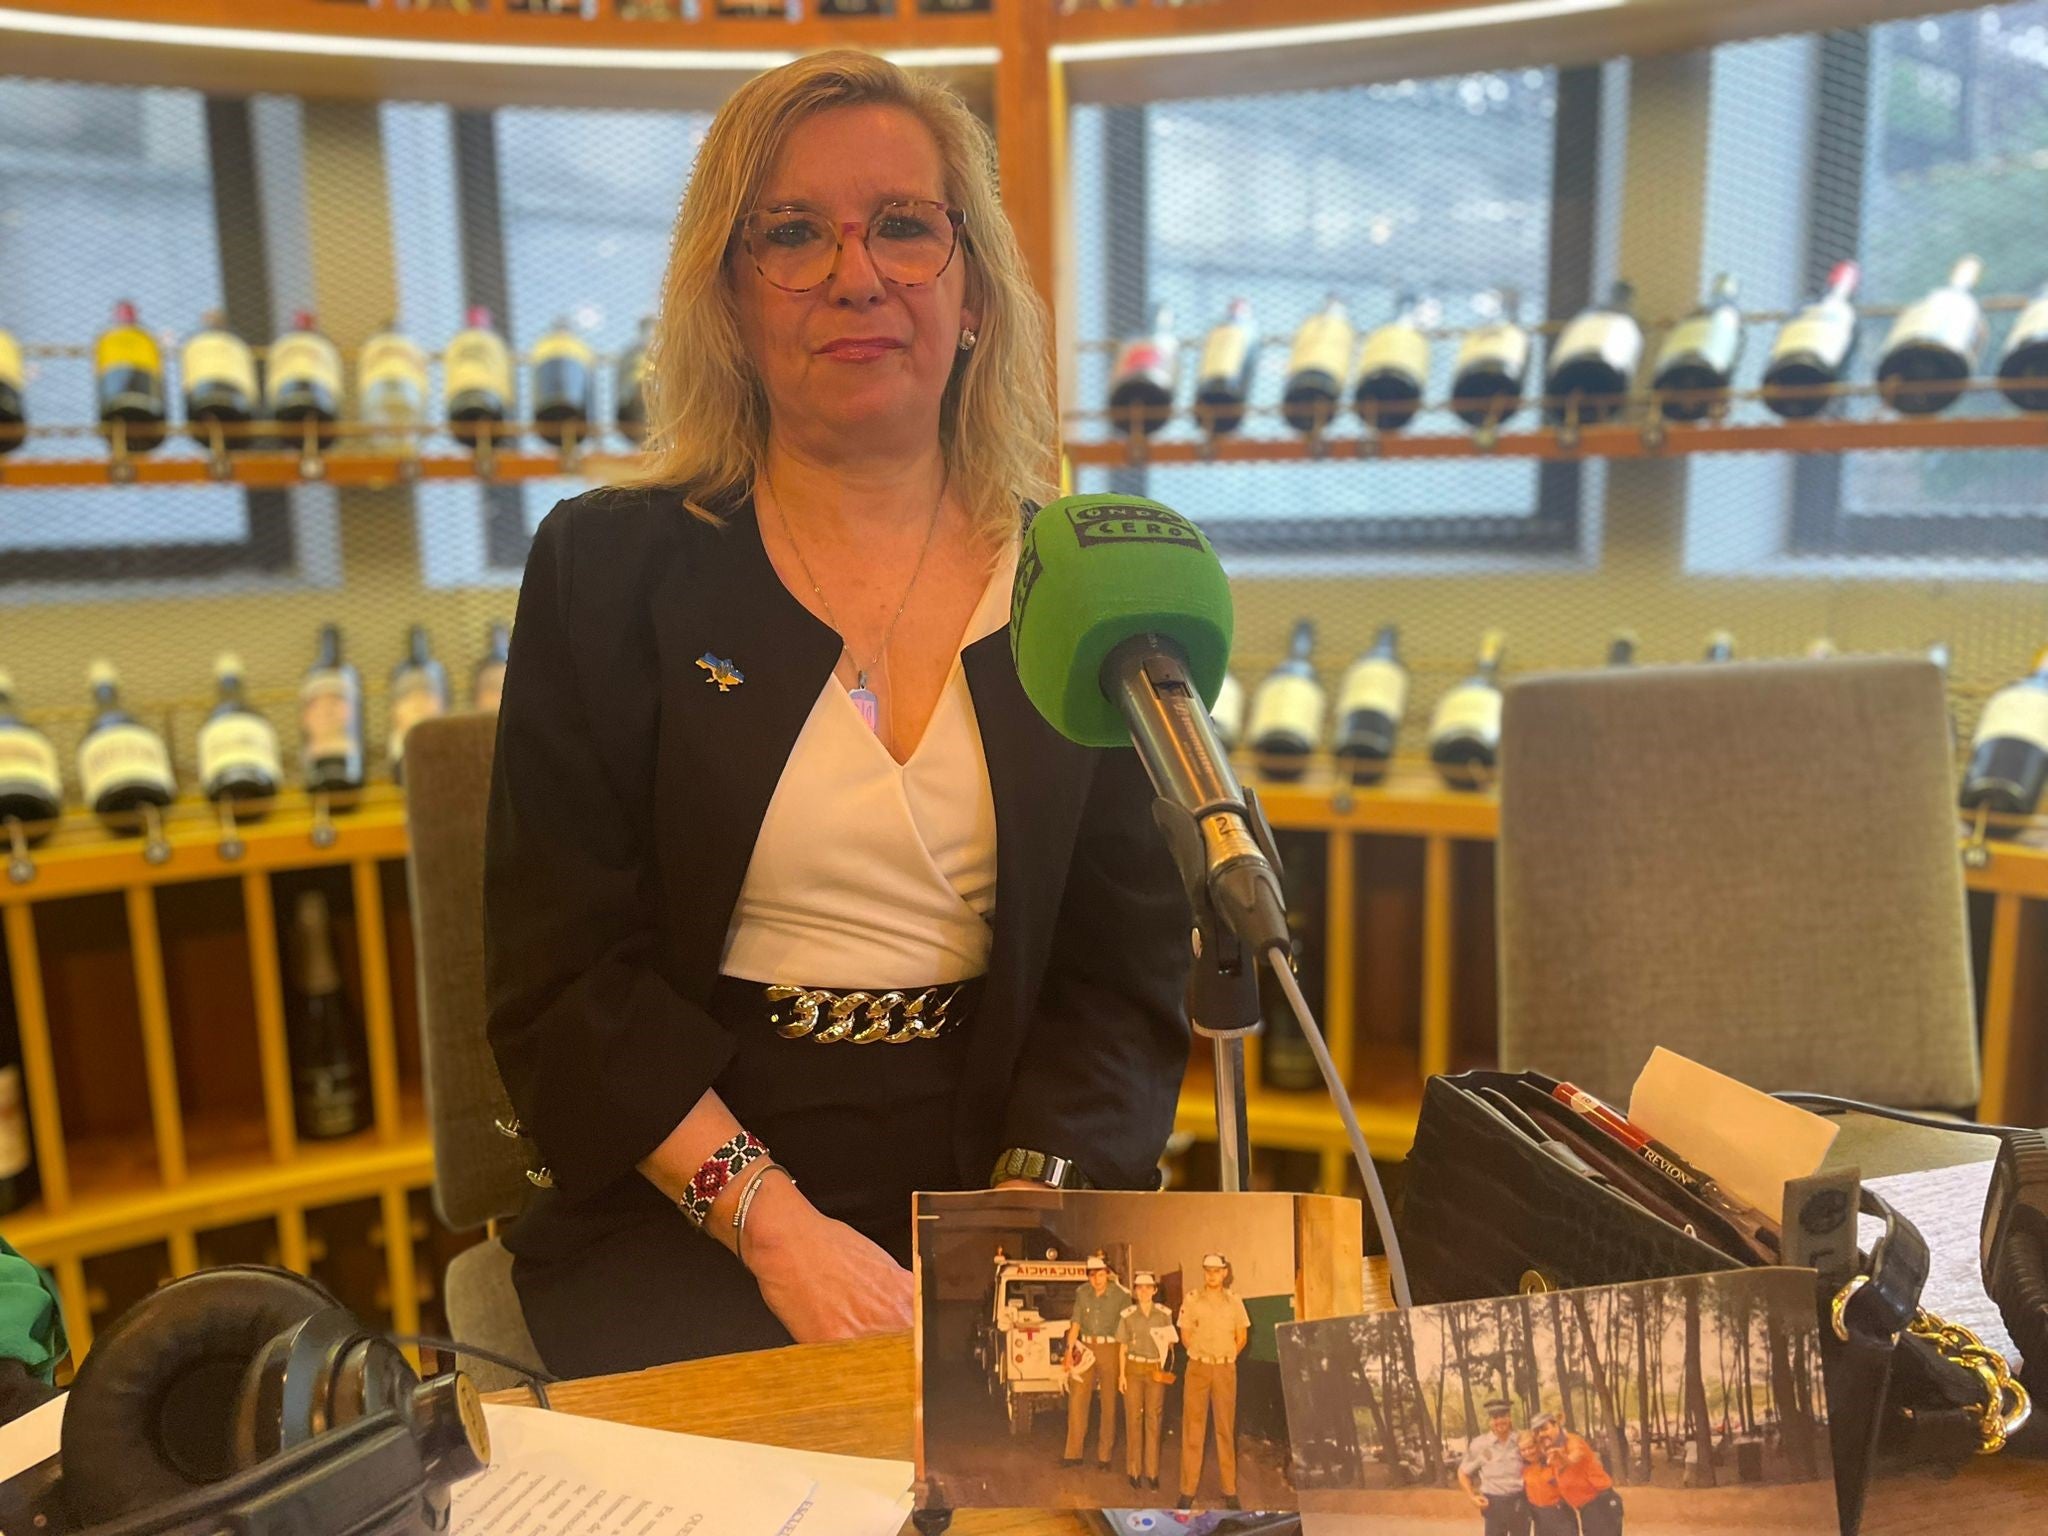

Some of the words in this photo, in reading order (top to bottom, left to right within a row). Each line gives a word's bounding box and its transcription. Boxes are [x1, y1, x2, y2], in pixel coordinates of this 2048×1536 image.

[1085, 507, 1175, 520] ONDA
[1098, 521, 1183, 537] CERO
[1643, 1150, 1688, 1185] REVLON
